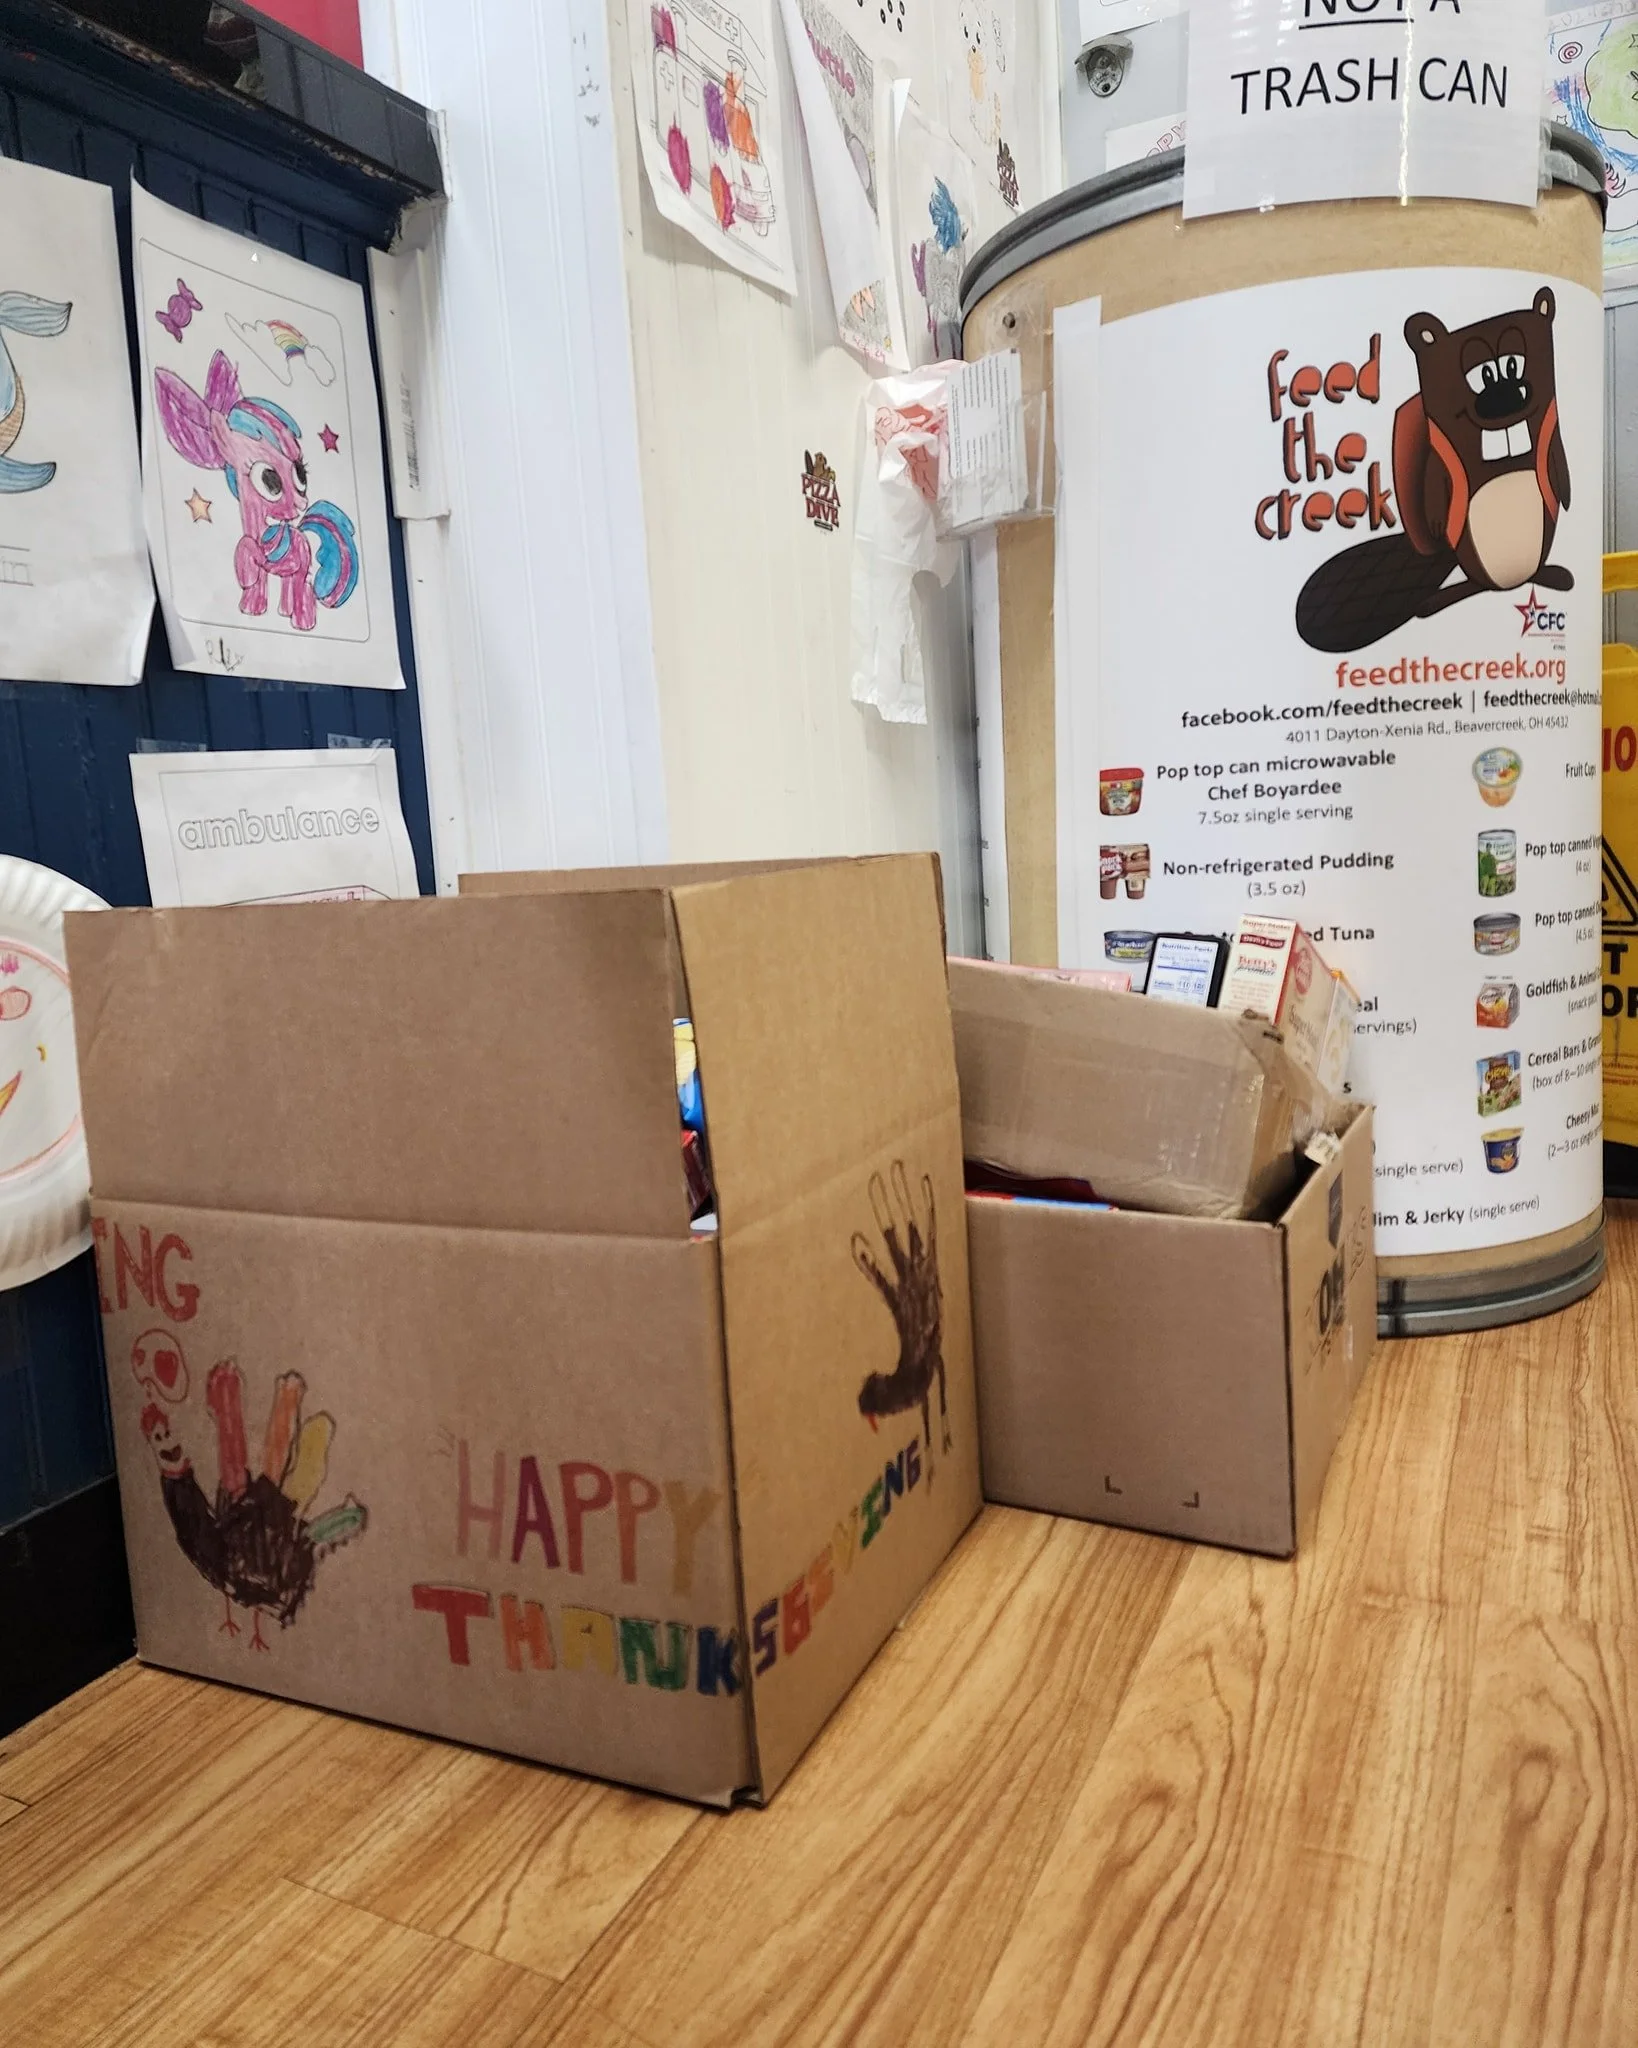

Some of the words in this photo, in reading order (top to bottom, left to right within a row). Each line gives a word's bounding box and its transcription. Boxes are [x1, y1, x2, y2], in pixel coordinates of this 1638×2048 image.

[1231, 57, 1398, 114] TRASH
[1419, 57, 1507, 108] CAN
[1268, 333, 1381, 422] feed
[1283, 411, 1367, 484] the
[1255, 462, 1397, 540] creek
[1537, 612, 1566, 630] CFC
[1336, 652, 1567, 689] feedthecreek.org
[1182, 692, 1463, 728] facebook.com/feedthecreek
[1286, 730, 1321, 743] 4011
[1327, 725, 1423, 743] Dayton-Xenia
[1455, 717, 1527, 734] Beavercreek,
[1529, 718, 1544, 729] OH
[1545, 716, 1569, 728] 45432
[1157, 765, 1189, 781] Pop
[1194, 764, 1224, 779] top
[1229, 761, 1260, 774] can
[1266, 750, 1397, 773] microwavable
[1566, 763, 1583, 778] Fruit
[1208, 783, 1250, 801] Chef
[1254, 779, 1342, 801] Boyardee
[1199, 811, 1240, 825] 7.5oz
[1245, 807, 1291, 824] single
[1296, 804, 1353, 820] serving
[178, 806, 380, 850] ambulance
[1525, 843, 1547, 858] Pop
[1550, 842, 1566, 857] top
[1568, 836, 1592, 852] canned
[1163, 856, 1314, 877] Non-refrigerated
[1320, 852, 1395, 870] Pudding
[1247, 882, 1277, 898] (3.5
[1282, 880, 1306, 897] oz)
[1535, 913, 1555, 927] Pop
[1558, 911, 1572, 925] top
[1330, 926, 1375, 941] Tuna
[1526, 976, 1568, 998] Goldfish
[1570, 975, 1577, 990] &
[1354, 1017, 1417, 1036] ervings)
[1528, 1049, 1561, 1067] Cereal
[1563, 1044, 1581, 1060] Bars
[1533, 1075, 1552, 1091] (box
[1555, 1070, 1564, 1085] of
[1566, 1110, 1590, 1130] Cheesy
[1422, 1159, 1464, 1175] serve)
[1405, 1211, 1418, 1225] &
[1423, 1208, 1465, 1226] Jerky
[1469, 1200, 1506, 1222] (single
[1509, 1196, 1540, 1213] serve)
[455, 1440, 723, 1597] HAPPY
